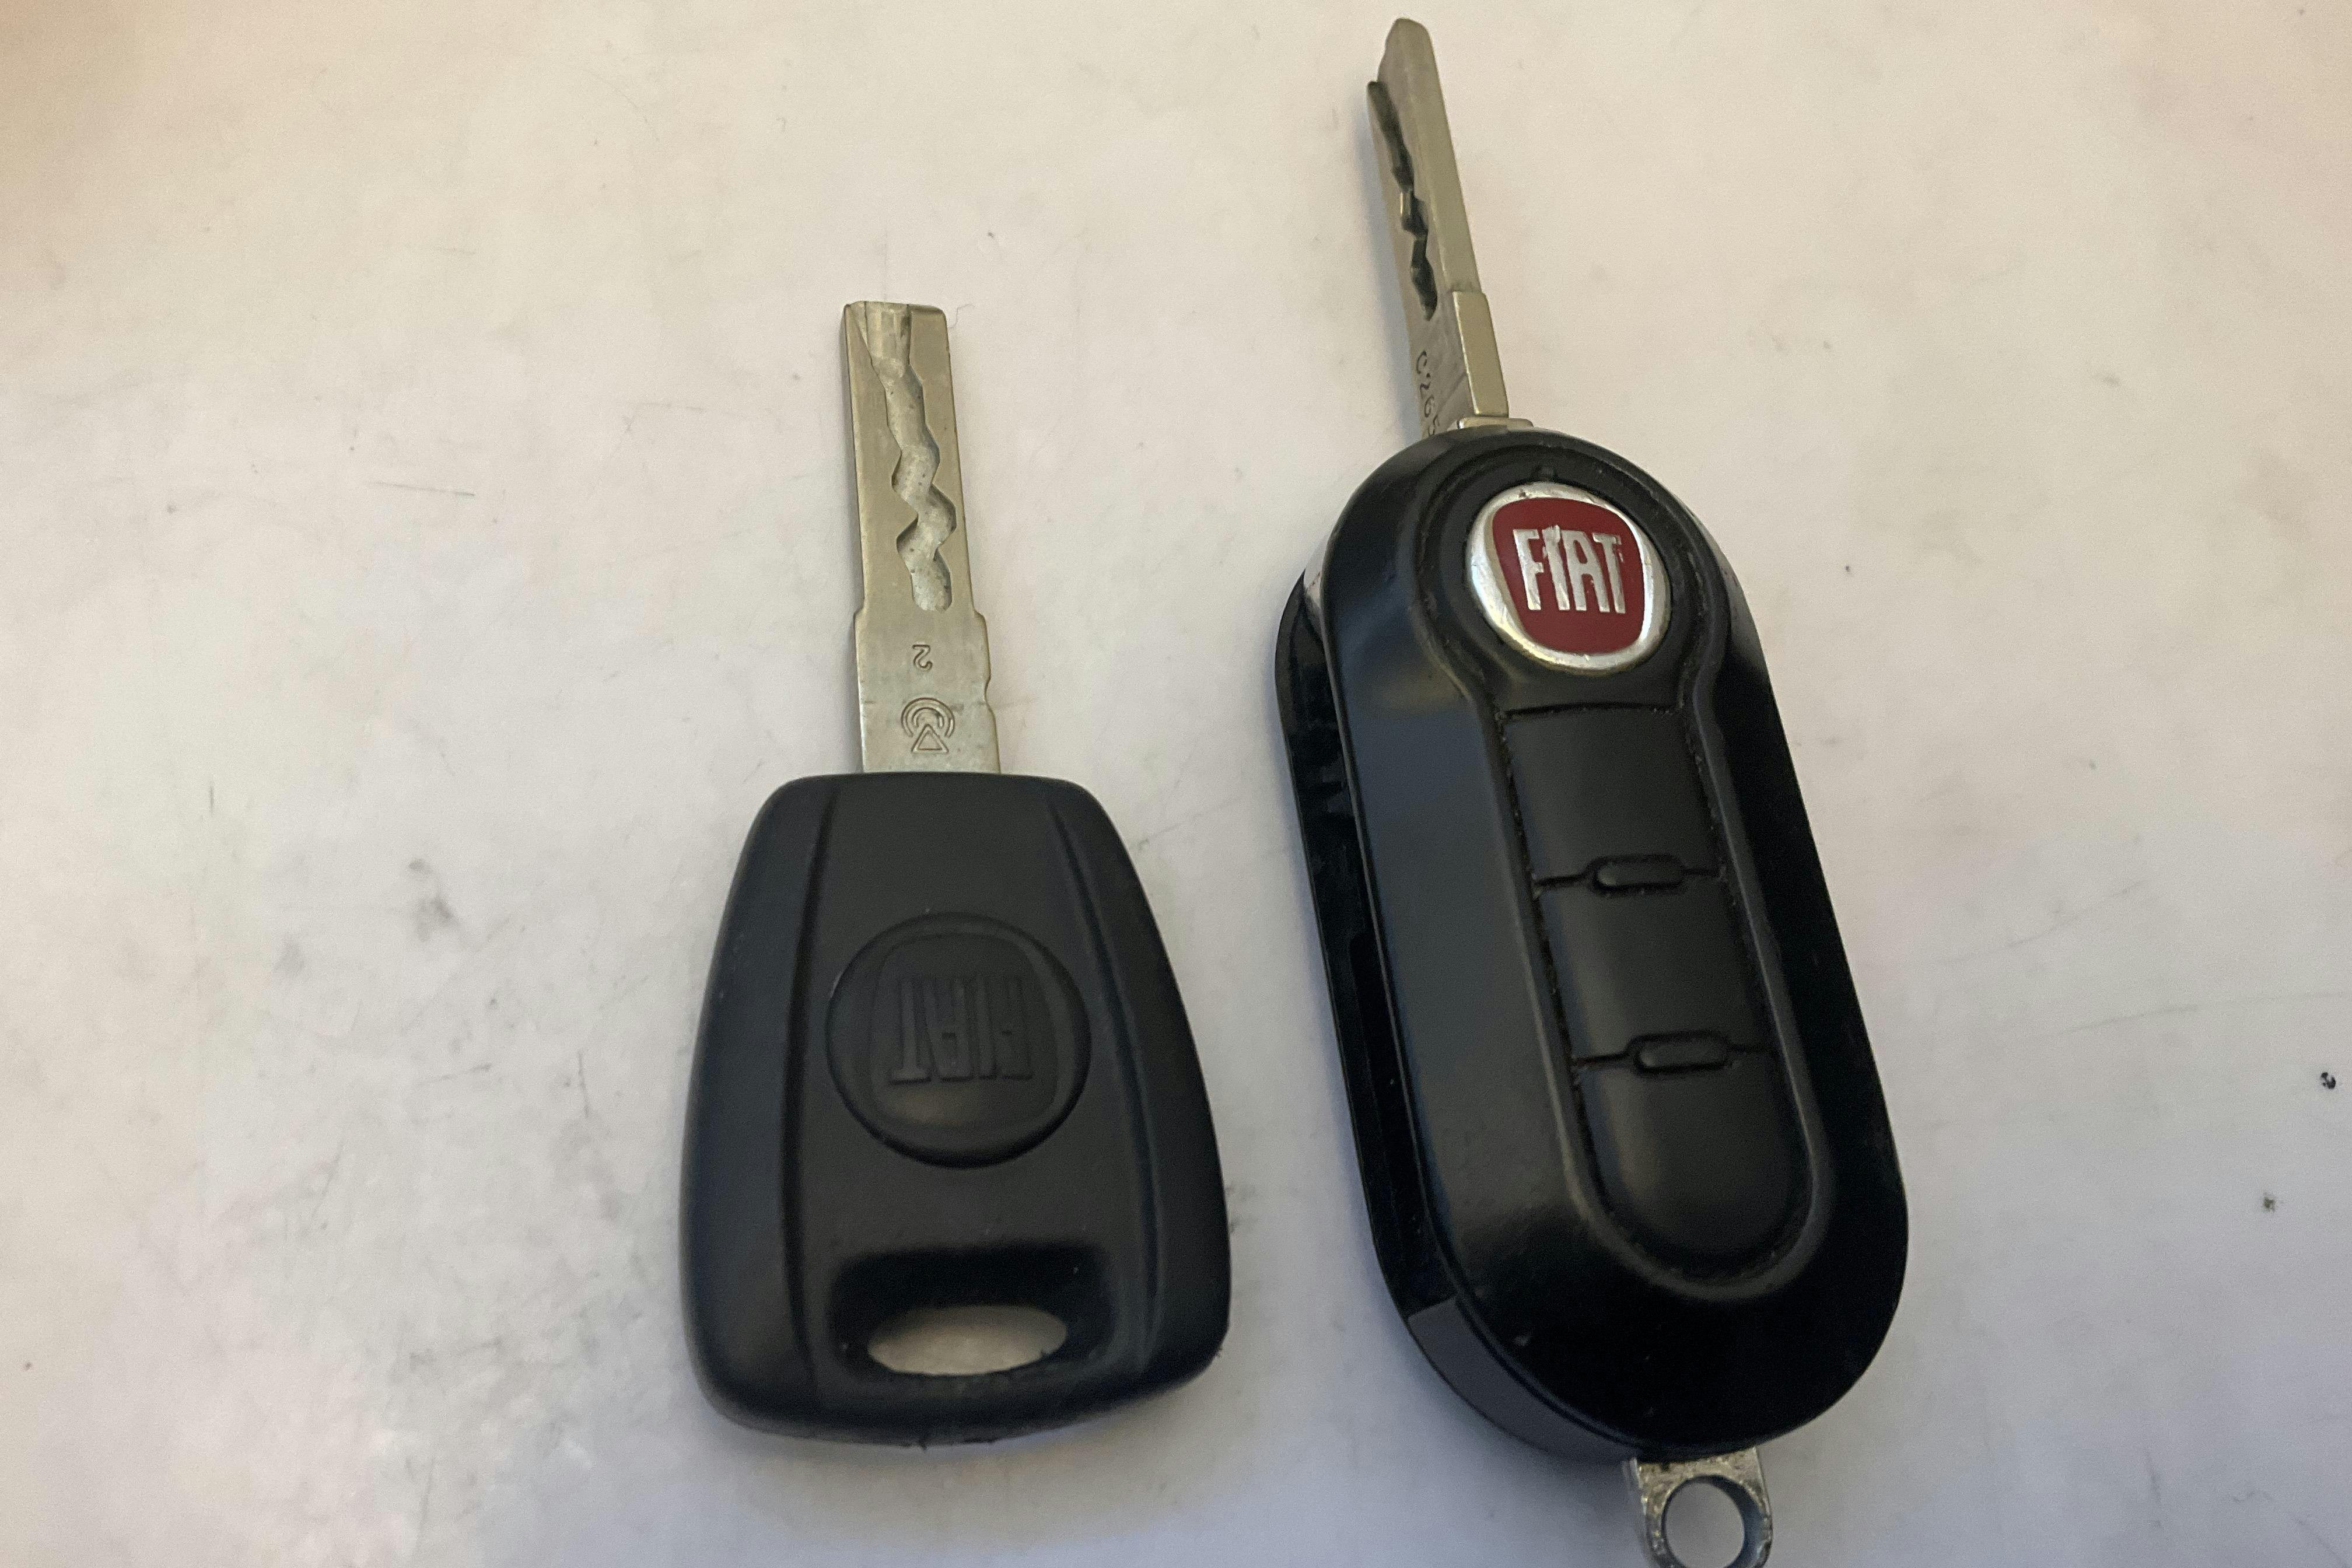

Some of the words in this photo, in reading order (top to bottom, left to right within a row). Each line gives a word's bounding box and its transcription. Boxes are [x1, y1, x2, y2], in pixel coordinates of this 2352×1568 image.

[1513, 524, 1626, 614] FIAT
[912, 643, 933, 670] 2
[888, 976, 1034, 1085] FIAT
